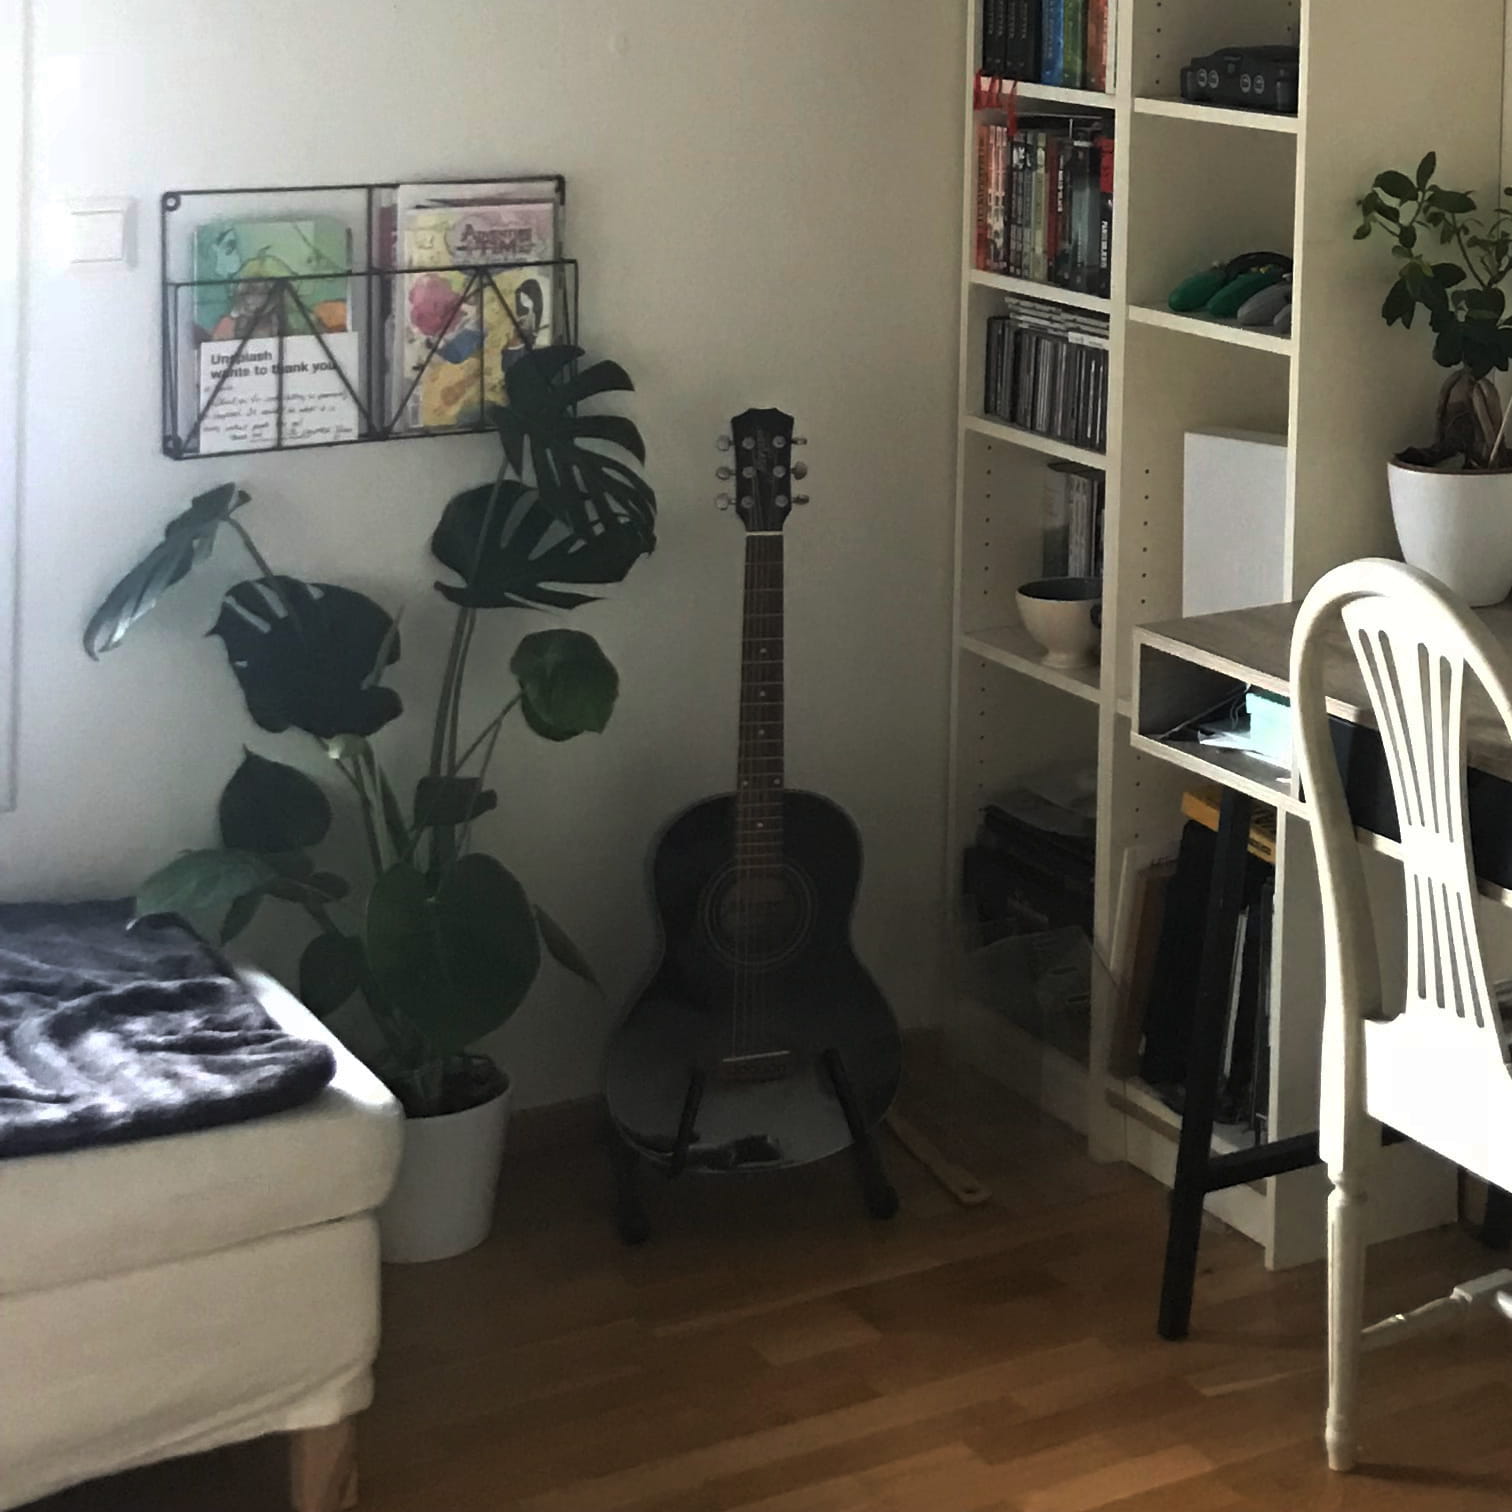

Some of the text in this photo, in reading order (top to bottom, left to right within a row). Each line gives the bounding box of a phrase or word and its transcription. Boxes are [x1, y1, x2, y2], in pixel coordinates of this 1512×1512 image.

[210, 367, 250, 379] wnts
[255, 366, 268, 376] to
[271, 361, 309, 375] tank
